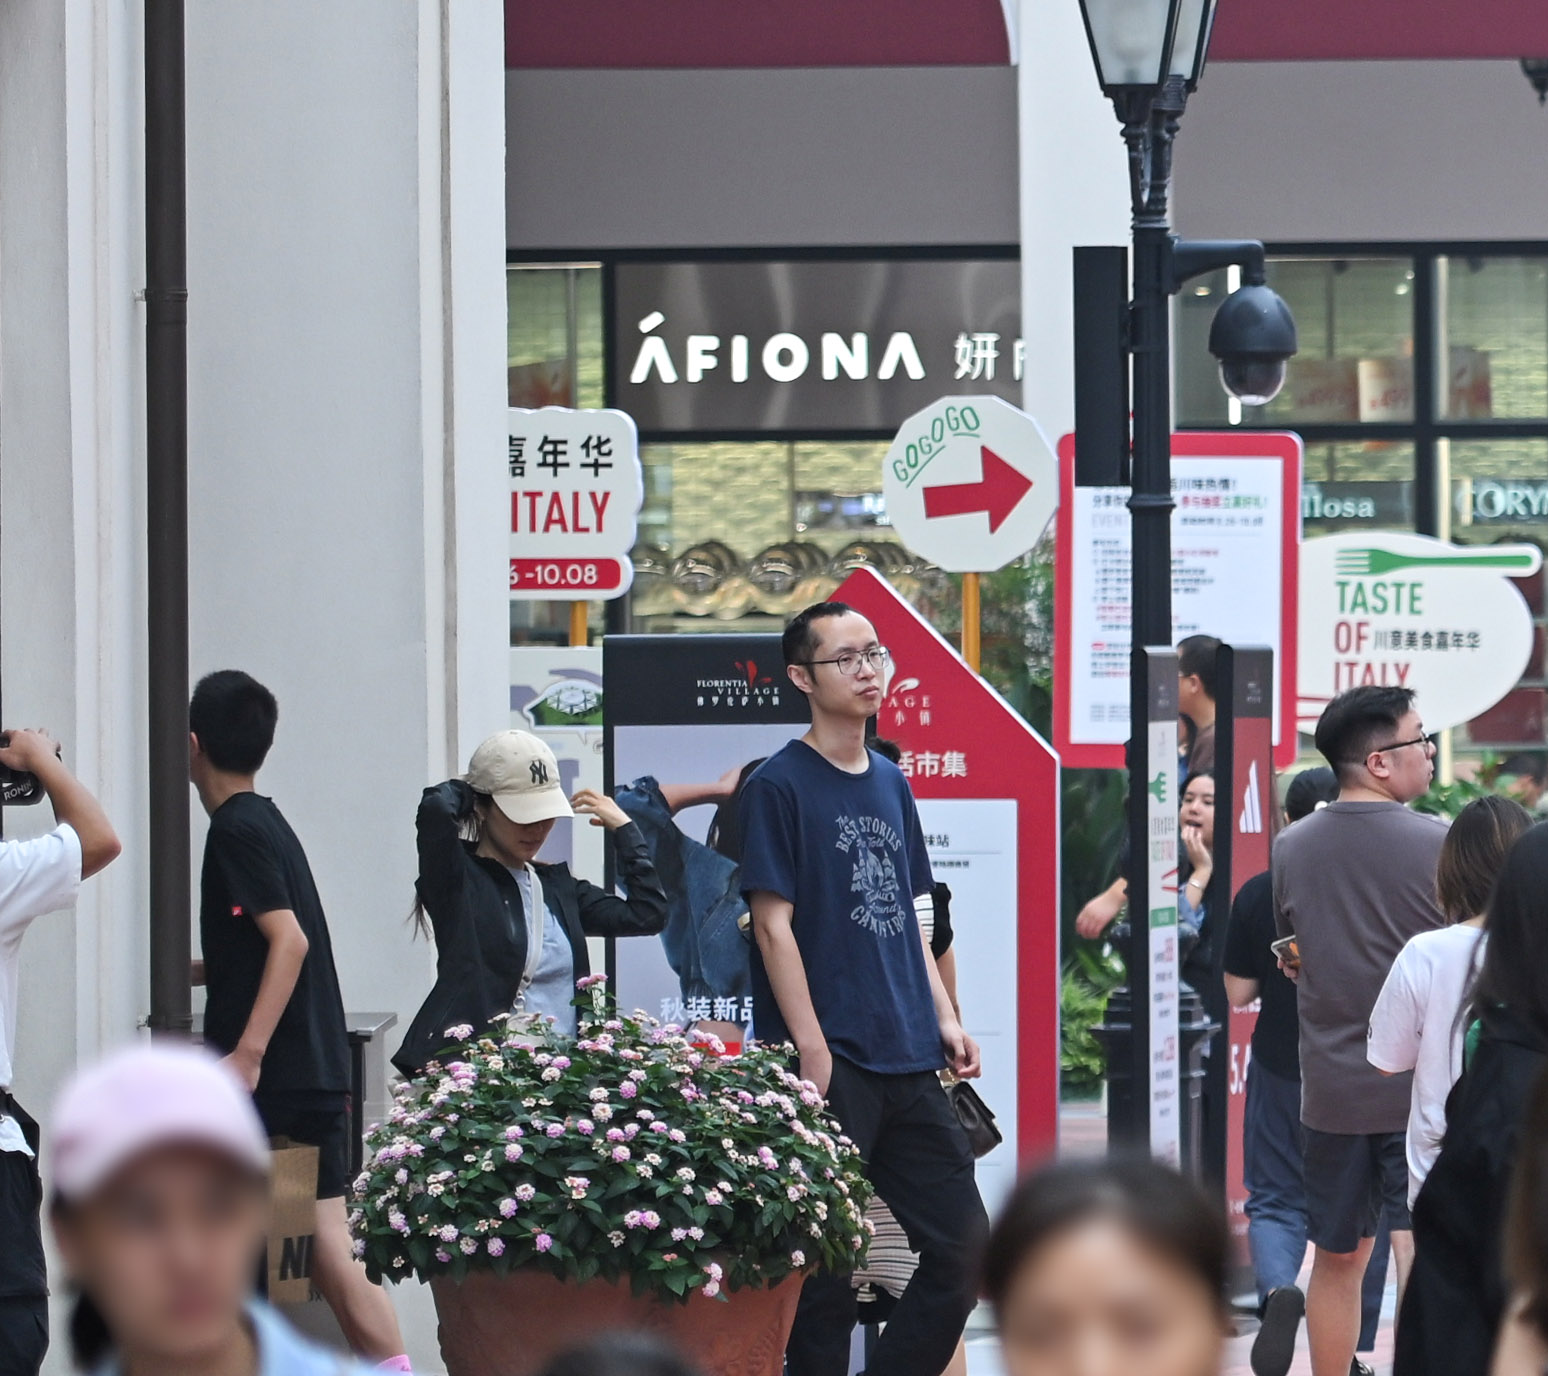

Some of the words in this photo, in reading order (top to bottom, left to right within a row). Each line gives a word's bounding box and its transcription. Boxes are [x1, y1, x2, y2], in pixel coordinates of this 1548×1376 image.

[953, 332, 1026, 381] 妍
[511, 491, 611, 533] ITALY
[1335, 581, 1423, 615] TASTE
[1334, 621, 1371, 654] OF
[697, 679, 748, 688] FLORENTIA
[717, 687, 780, 696] VILLAGE
[835, 820, 860, 854] BEST
[858, 816, 902, 852] STORIES
